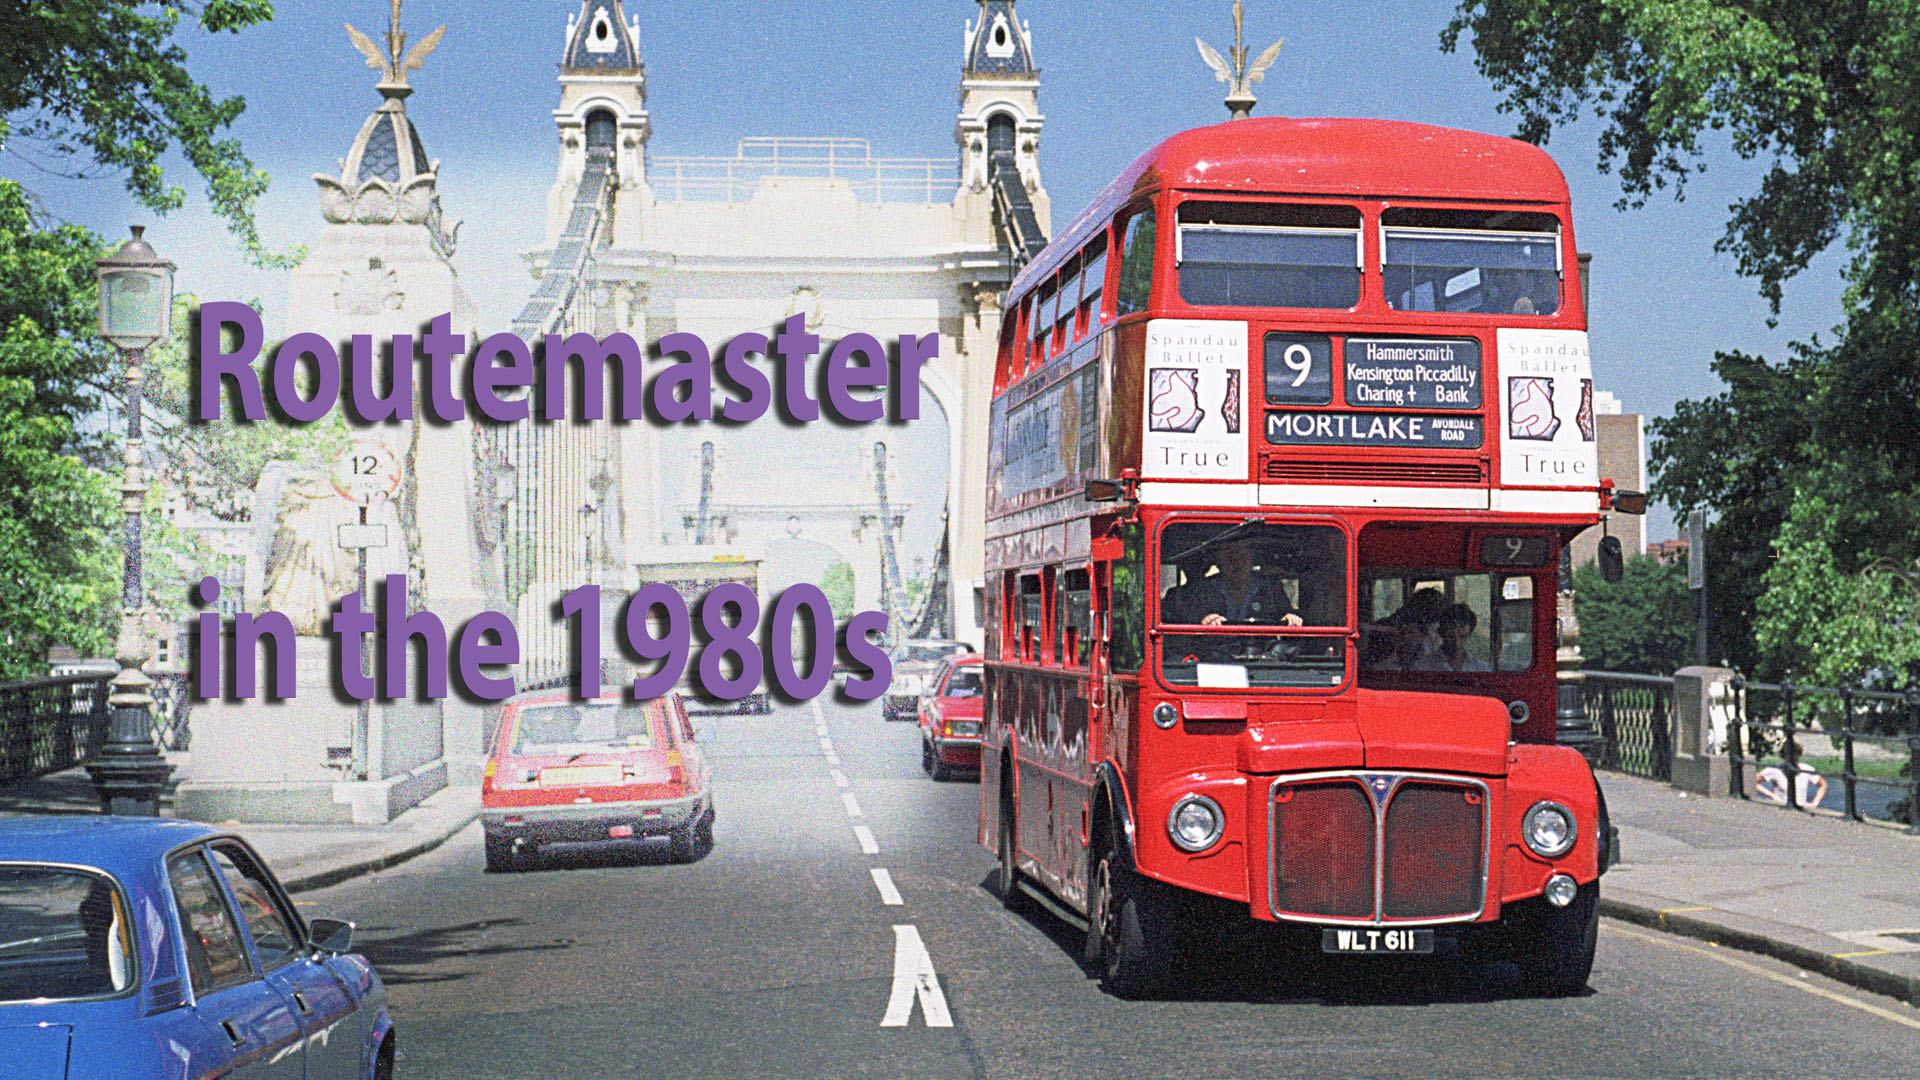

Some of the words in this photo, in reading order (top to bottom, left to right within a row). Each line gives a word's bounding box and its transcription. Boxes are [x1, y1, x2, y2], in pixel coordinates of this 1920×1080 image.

[1151, 334, 1238, 348] Spandau
[1508, 343, 1590, 357] Spandau
[1162, 352, 1225, 364] Ballet
[1367, 343, 1454, 361] Hammersmith
[1284, 344, 1312, 387] 9
[1521, 360, 1578, 373] Ballet
[1347, 364, 1413, 385] Kensington
[1415, 364, 1476, 387] Piccadilly
[1357, 384, 1404, 405] Charing
[1435, 385, 1469, 403] Bank
[1268, 414, 1424, 440] MORTLAKE
[1432, 418, 1474, 430] AVONDALE
[1441, 429, 1465, 441] ROAD
[351, 456, 377, 475] 12
[1160, 446, 1229, 467] True
[1520, 454, 1585, 474] True
[1506, 538, 1522, 559] 9
[1337, 930, 1381, 950] WLT
[1384, 930, 1414, 950] 611
